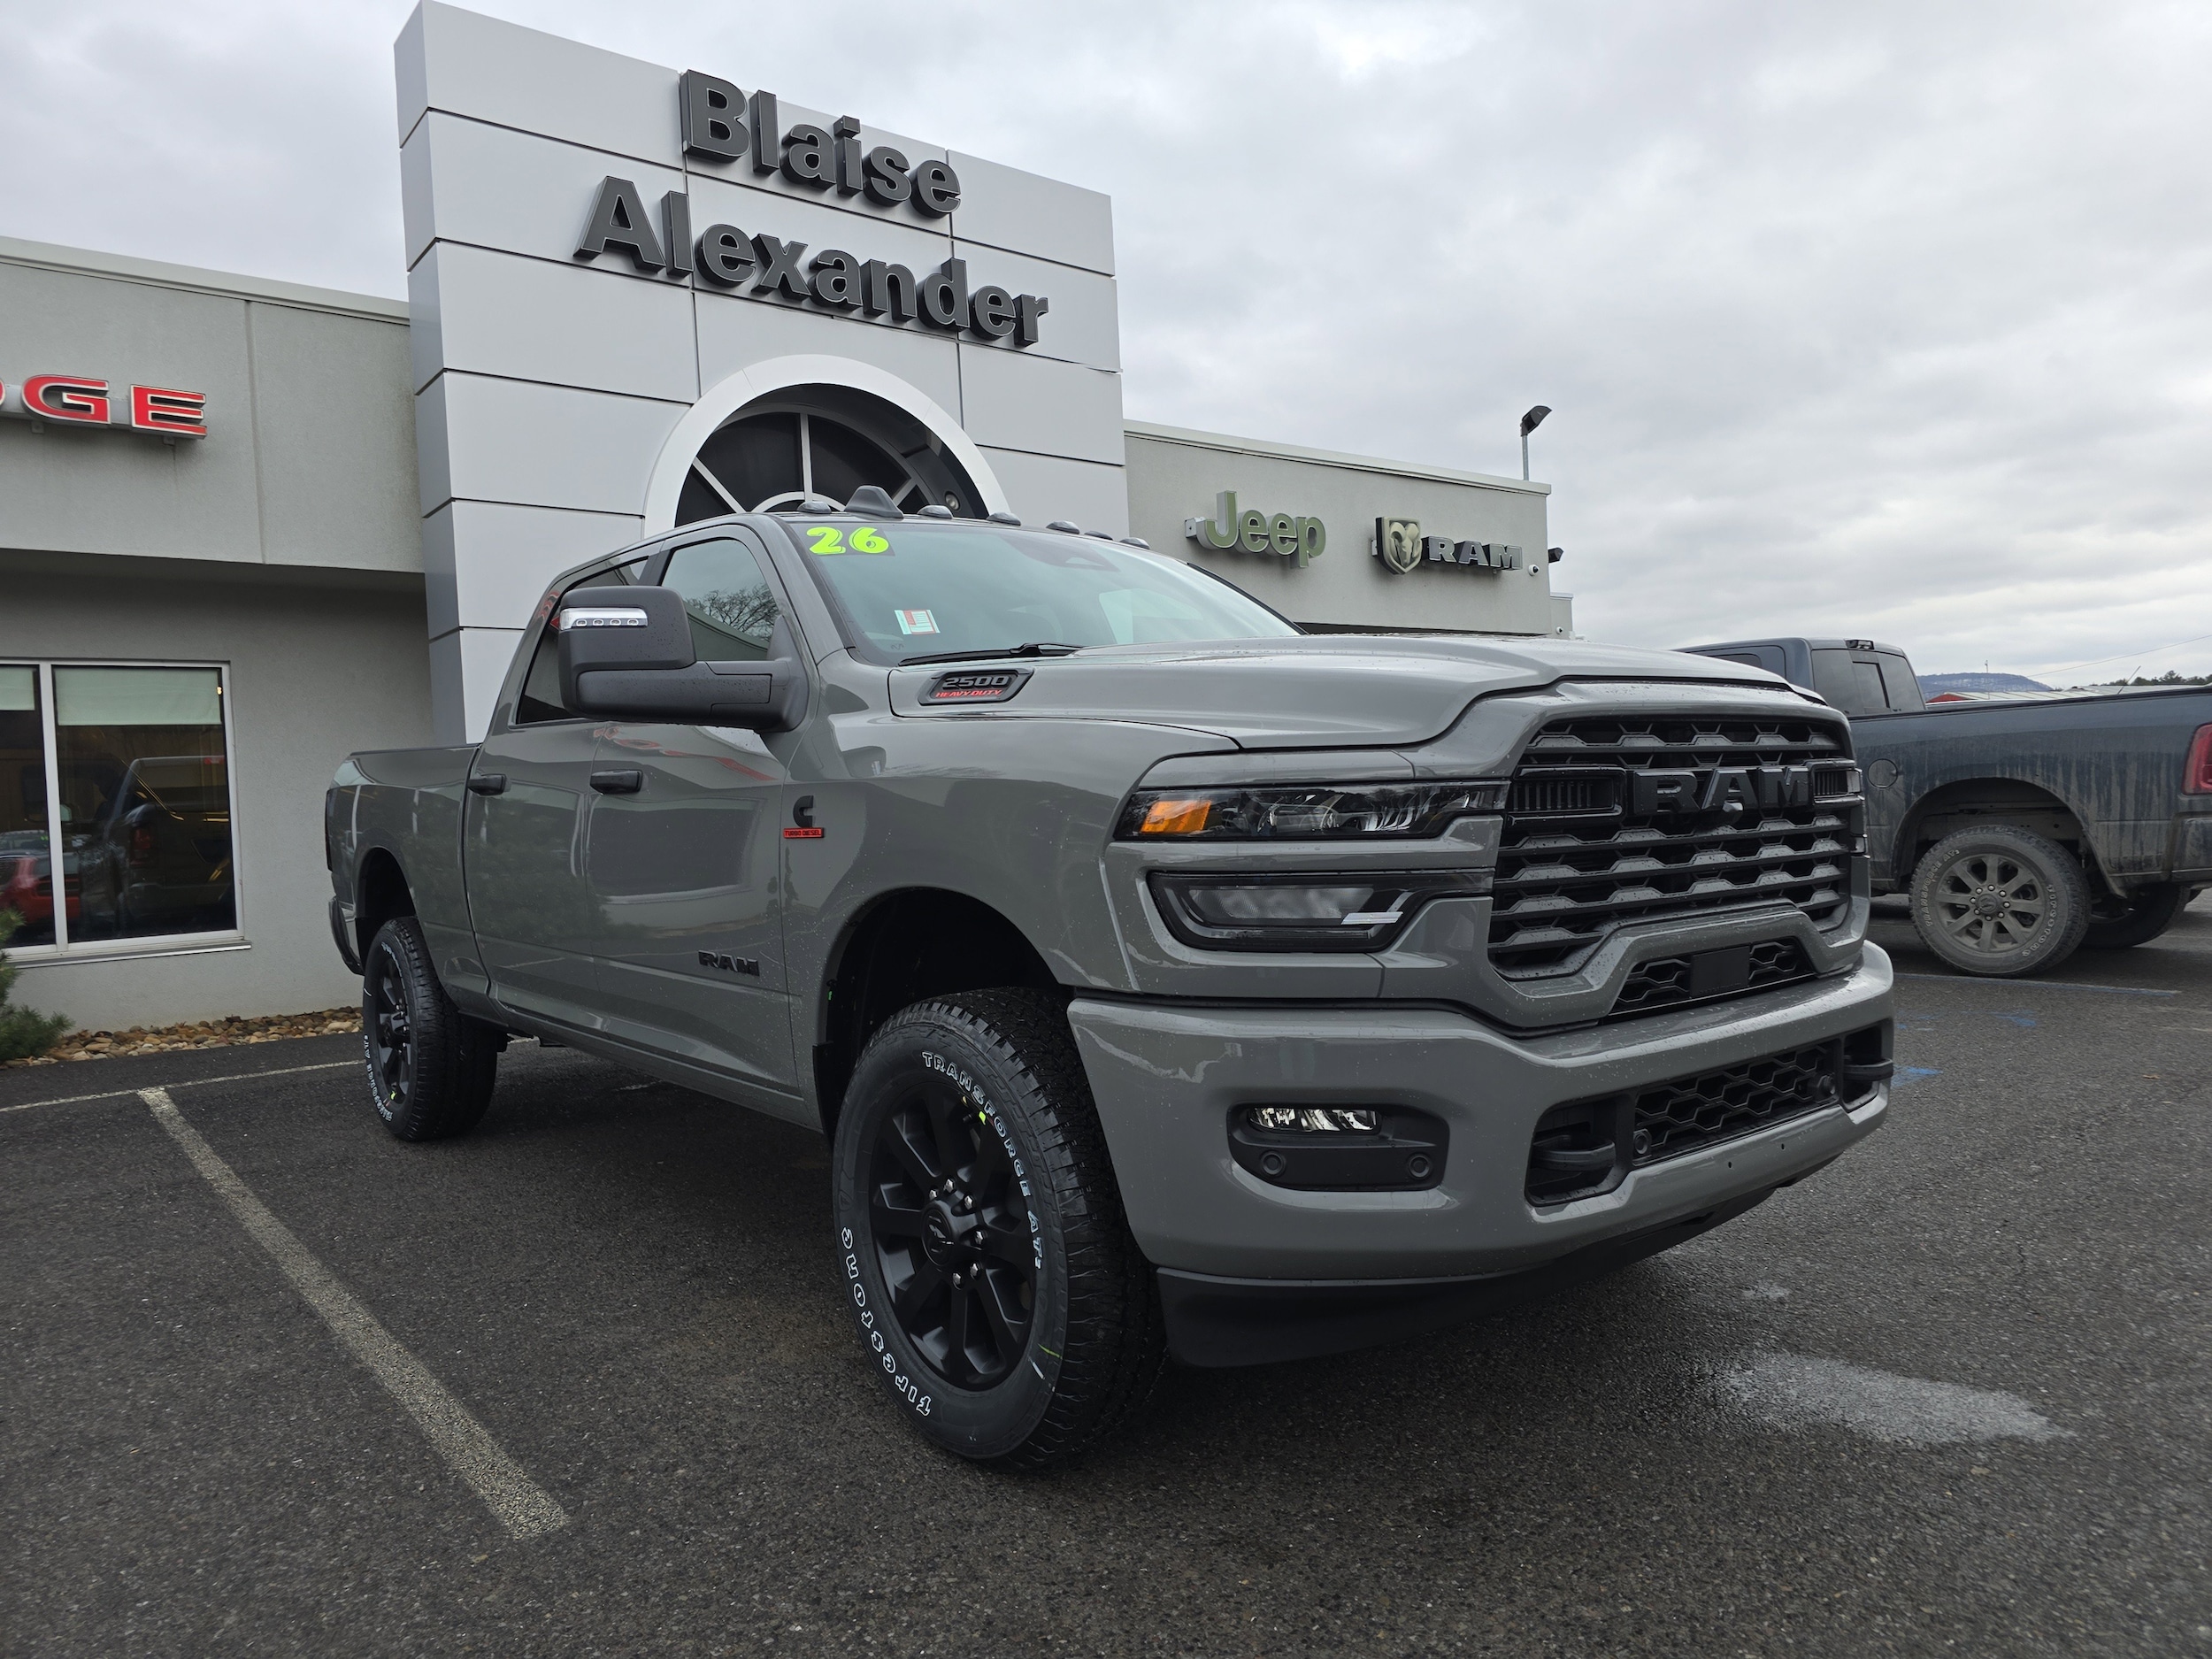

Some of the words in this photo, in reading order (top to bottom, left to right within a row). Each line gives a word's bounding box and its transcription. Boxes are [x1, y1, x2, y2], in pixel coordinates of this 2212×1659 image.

[680, 68, 962, 219] Blaise
[573, 175, 1049, 348] Alexander
[0, 374, 207, 440] GE
[806, 526, 889, 556] 26
[1195, 489, 1326, 568] Jeep
[1422, 535, 1524, 571] RAM
[941, 675, 1010, 690] 2500
[1632, 765, 1812, 817] RAM
[697, 949, 760, 977] RAM
[922, 1051, 1031, 1197] TRANSFORCE
